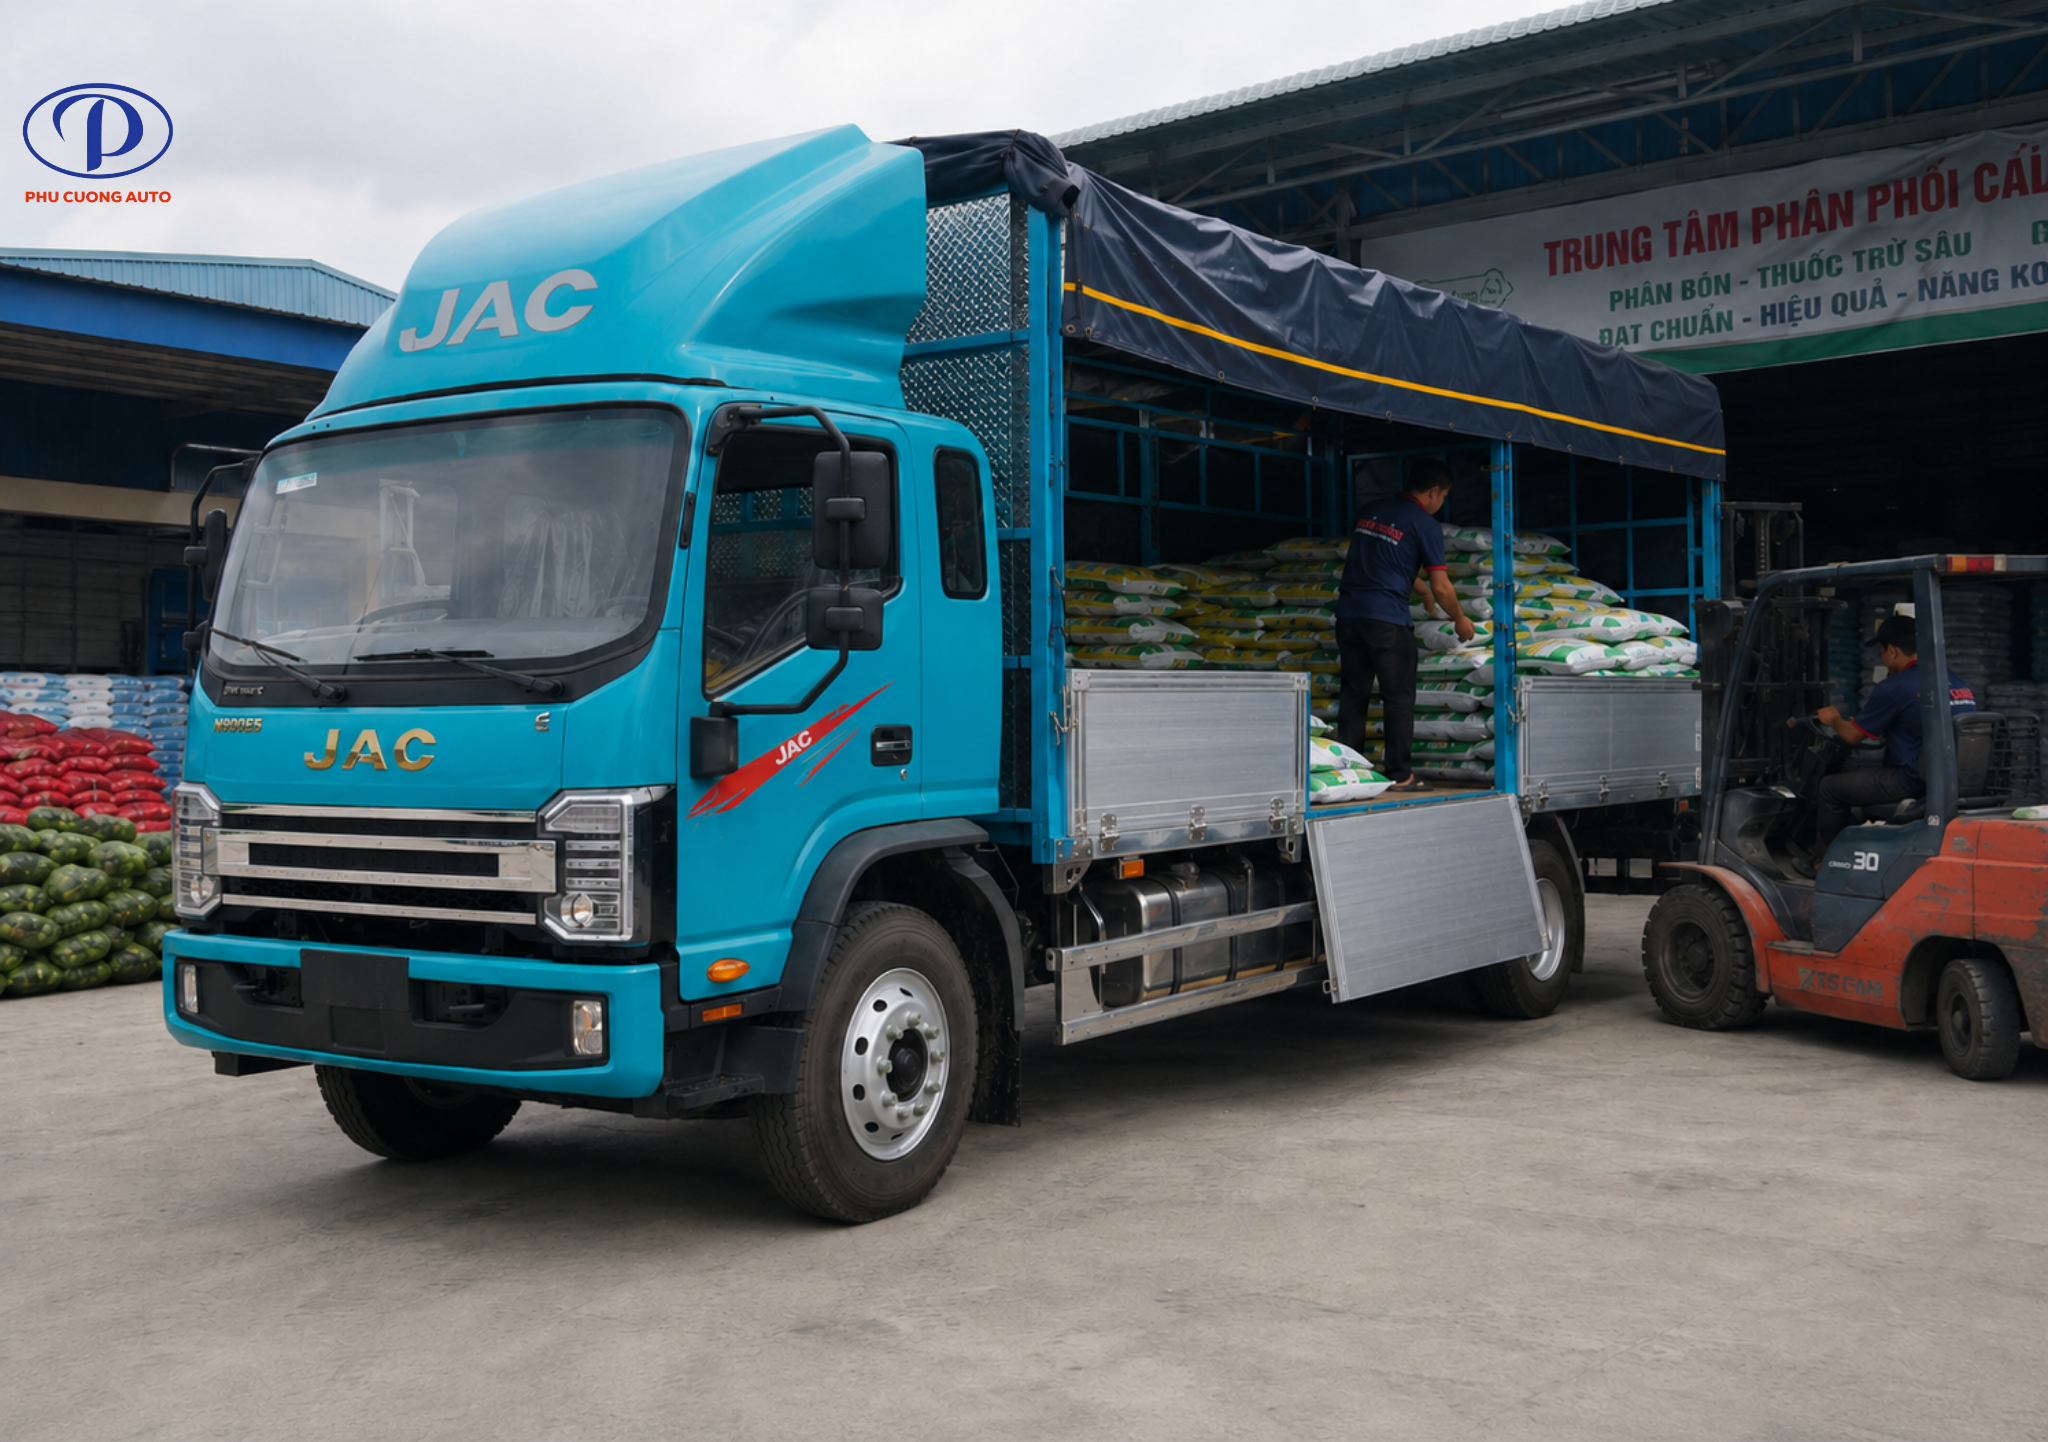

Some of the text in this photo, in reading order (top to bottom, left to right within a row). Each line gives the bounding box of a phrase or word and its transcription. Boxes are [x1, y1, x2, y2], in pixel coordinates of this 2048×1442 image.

[1543, 225, 1652, 277] TRUNG
[1663, 209, 1739, 258] TÂM
[1751, 188, 1854, 245] PHÂN
[1867, 157, 1959, 223] PHỐI
[1609, 280, 1672, 312] PHÂN
[1681, 271, 1731, 301] BÓN
[1757, 248, 1843, 289] THUỐC
[1852, 237, 1907, 273] TRỪ
[1915, 229, 1972, 263] SÂU
[1651, 303, 1734, 342] CHUẨN
[1760, 294, 1821, 327] HIỆU
[1831, 277, 1888, 317] QUẢ
[1917, 267, 1999, 302] NĂNG
[399, 268, 598, 353] JAC
[304, 728, 437, 771] JAC
[775, 730, 812, 765] JAC
[1852, 851, 1879, 871] 30
